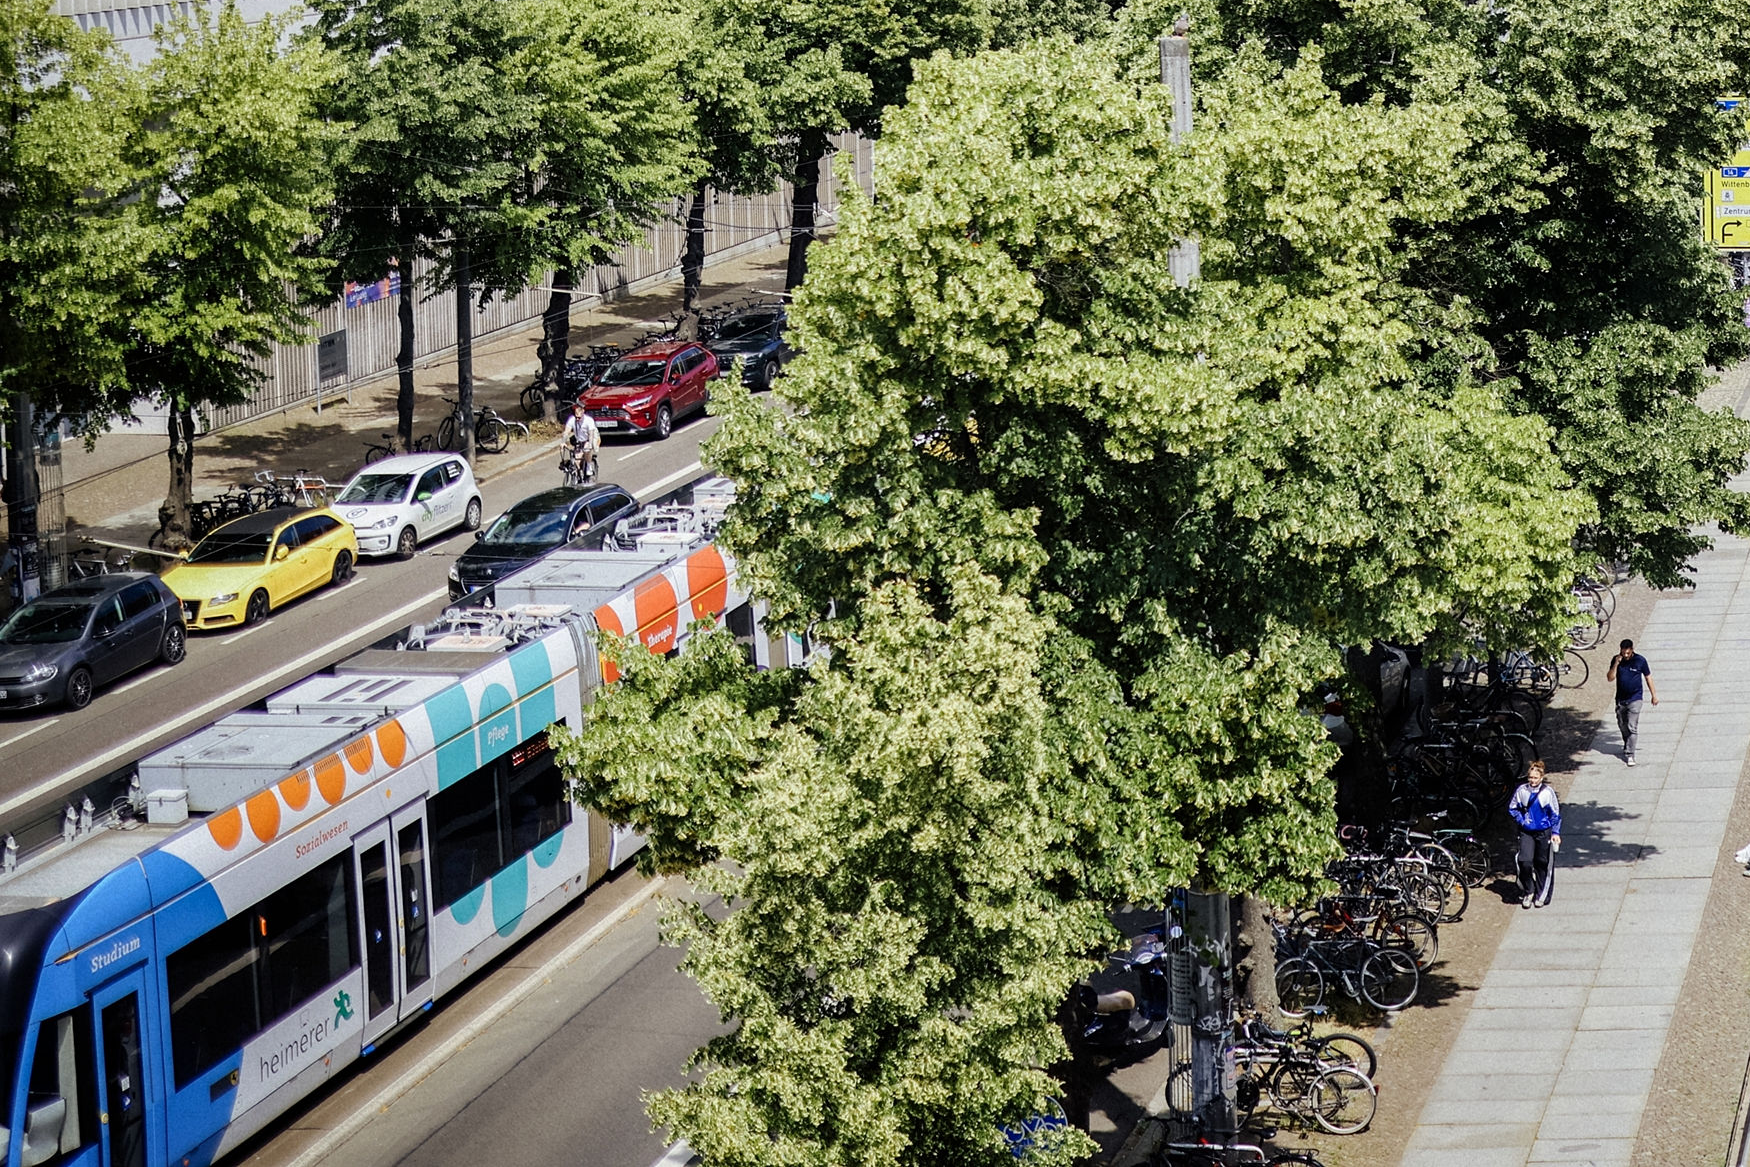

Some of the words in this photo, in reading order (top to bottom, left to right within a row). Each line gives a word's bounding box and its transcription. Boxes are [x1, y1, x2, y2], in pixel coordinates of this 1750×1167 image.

[487, 724, 509, 747] Pflege
[295, 820, 348, 859] Sozialwesen
[91, 937, 141, 973] Studium
[260, 1017, 330, 1082] heimerer
